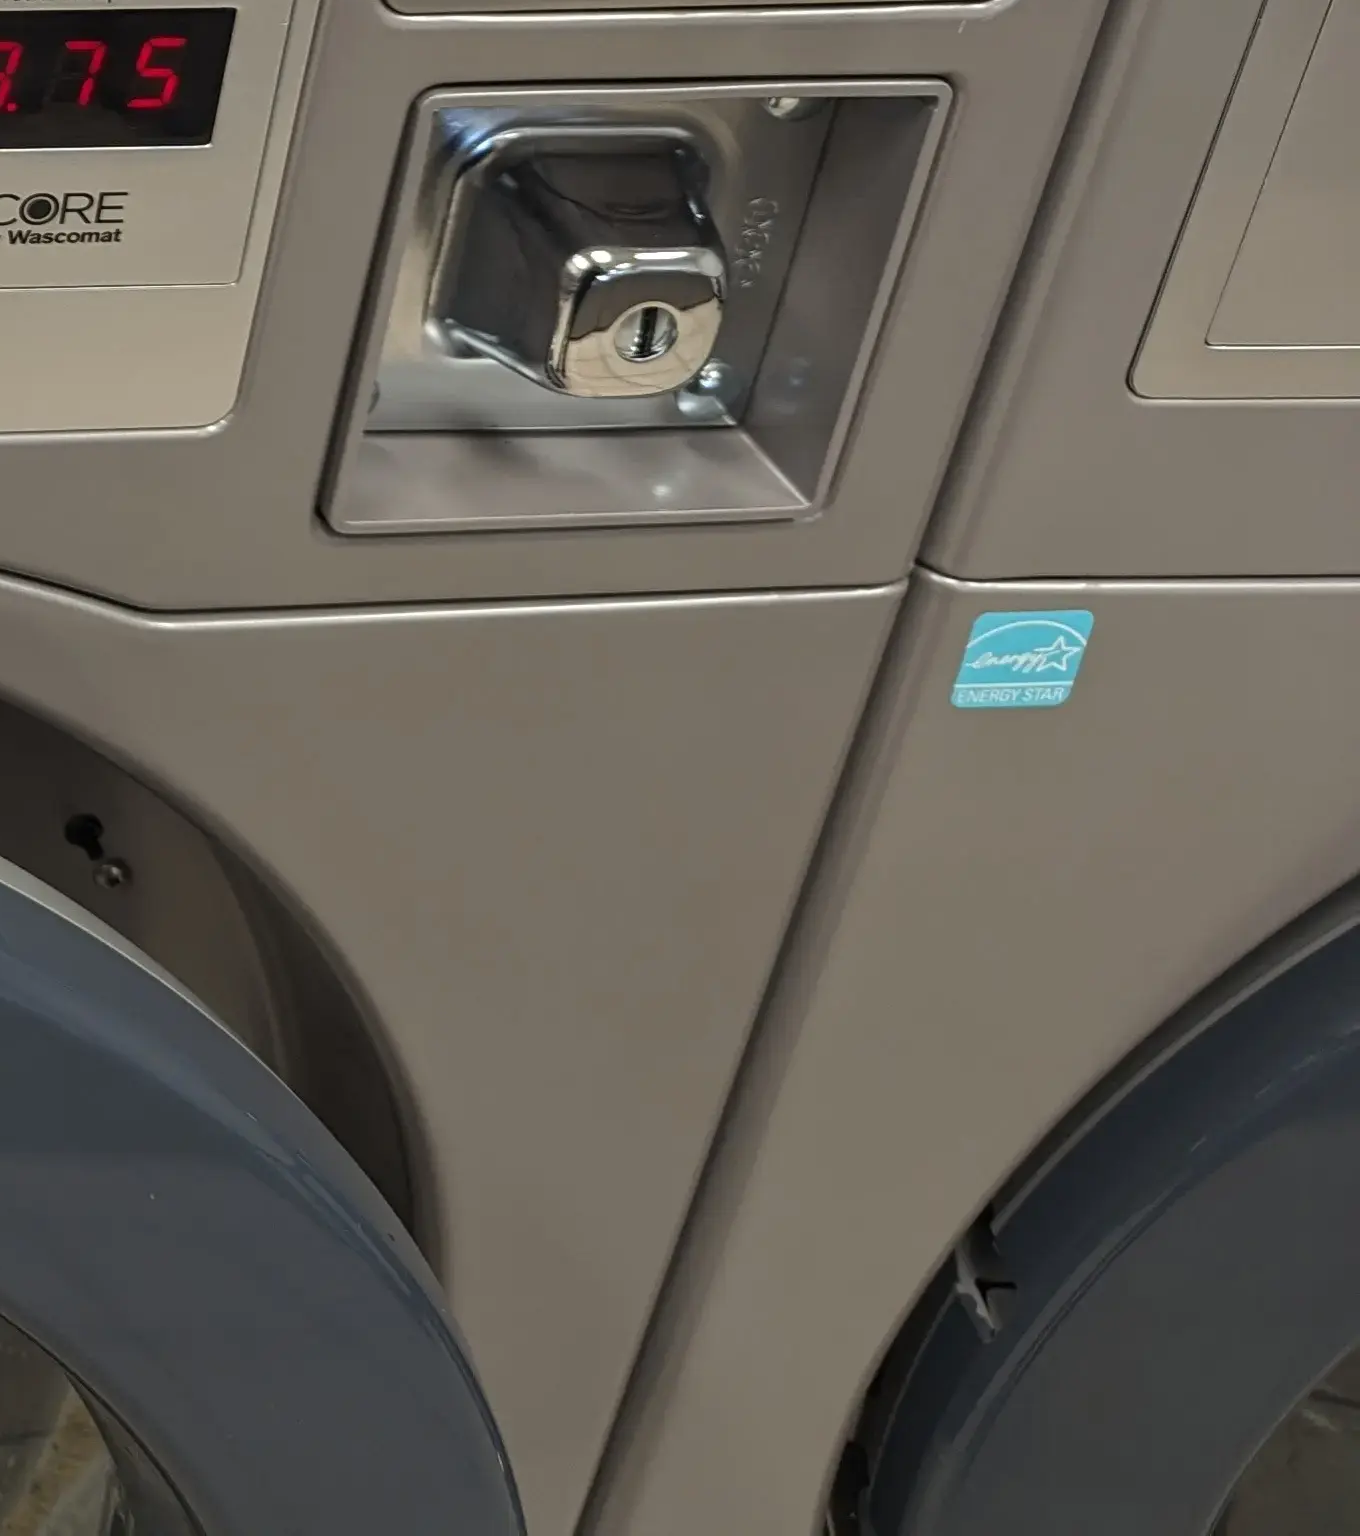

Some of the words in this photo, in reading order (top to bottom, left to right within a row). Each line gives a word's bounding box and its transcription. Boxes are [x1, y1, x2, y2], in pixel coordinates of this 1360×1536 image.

[7, 228, 122, 245] Wascomat
[957, 688, 1022, 703] ENERGY
[1022, 687, 1064, 701] STAR
